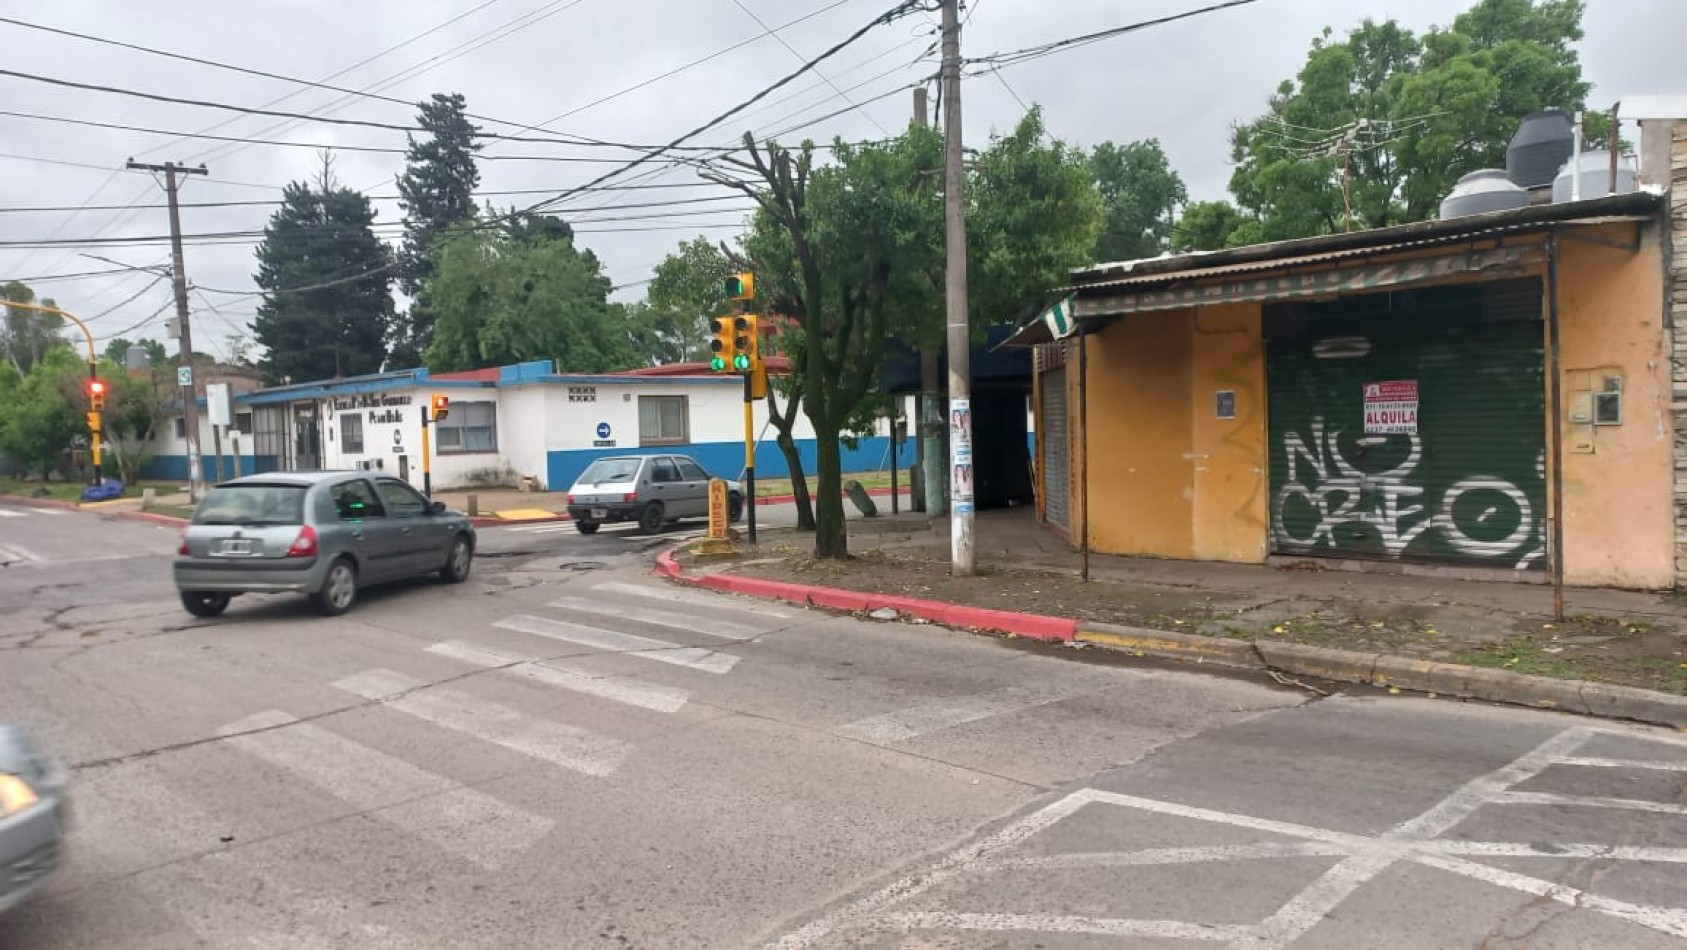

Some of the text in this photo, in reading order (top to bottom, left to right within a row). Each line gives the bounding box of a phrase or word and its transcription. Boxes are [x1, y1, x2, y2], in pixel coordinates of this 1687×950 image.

[1284, 415, 1422, 479] NO
[1366, 410, 1416, 425] ALQUILA
[1273, 476, 1532, 558] CREO
